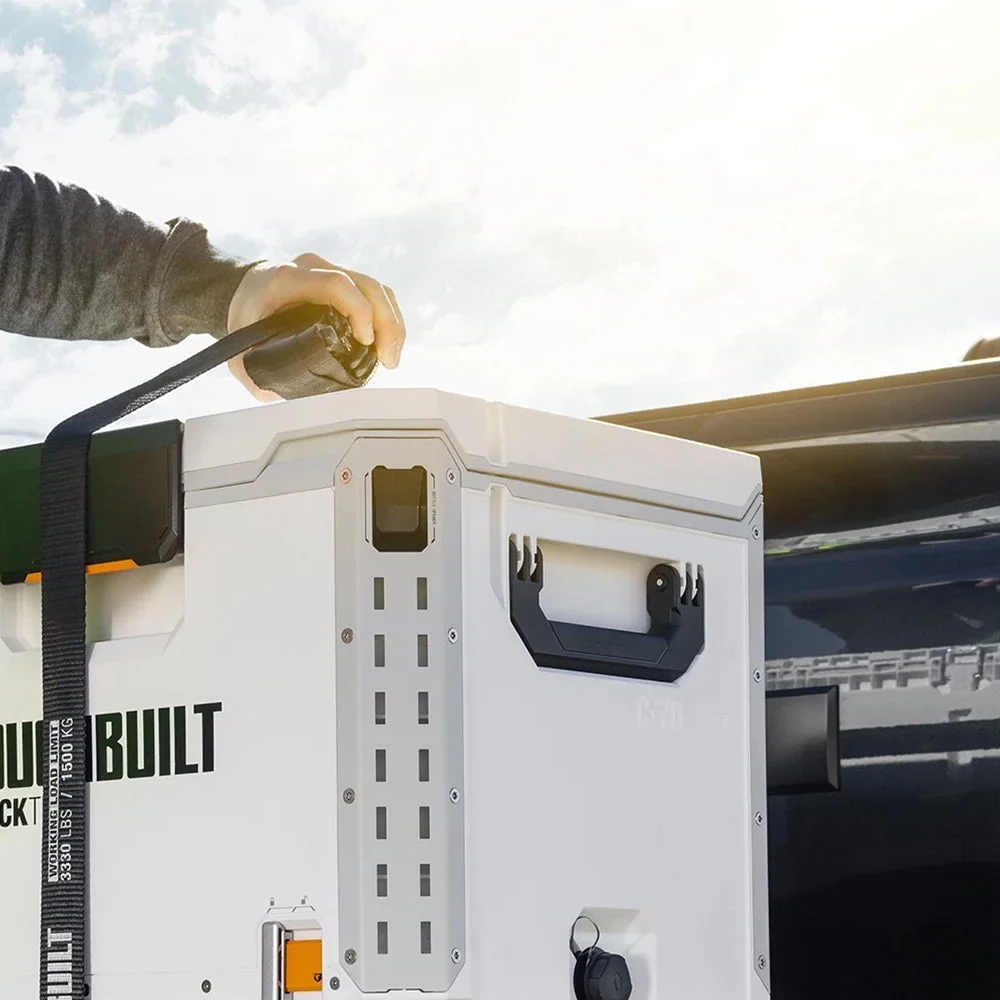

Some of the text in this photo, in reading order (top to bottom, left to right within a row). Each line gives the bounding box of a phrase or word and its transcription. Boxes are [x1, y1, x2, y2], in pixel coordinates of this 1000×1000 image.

[48, 723, 60, 878] WORKING LOAD LIMIT
[60, 717, 73, 882] 3330 LBS / 1500 KG
